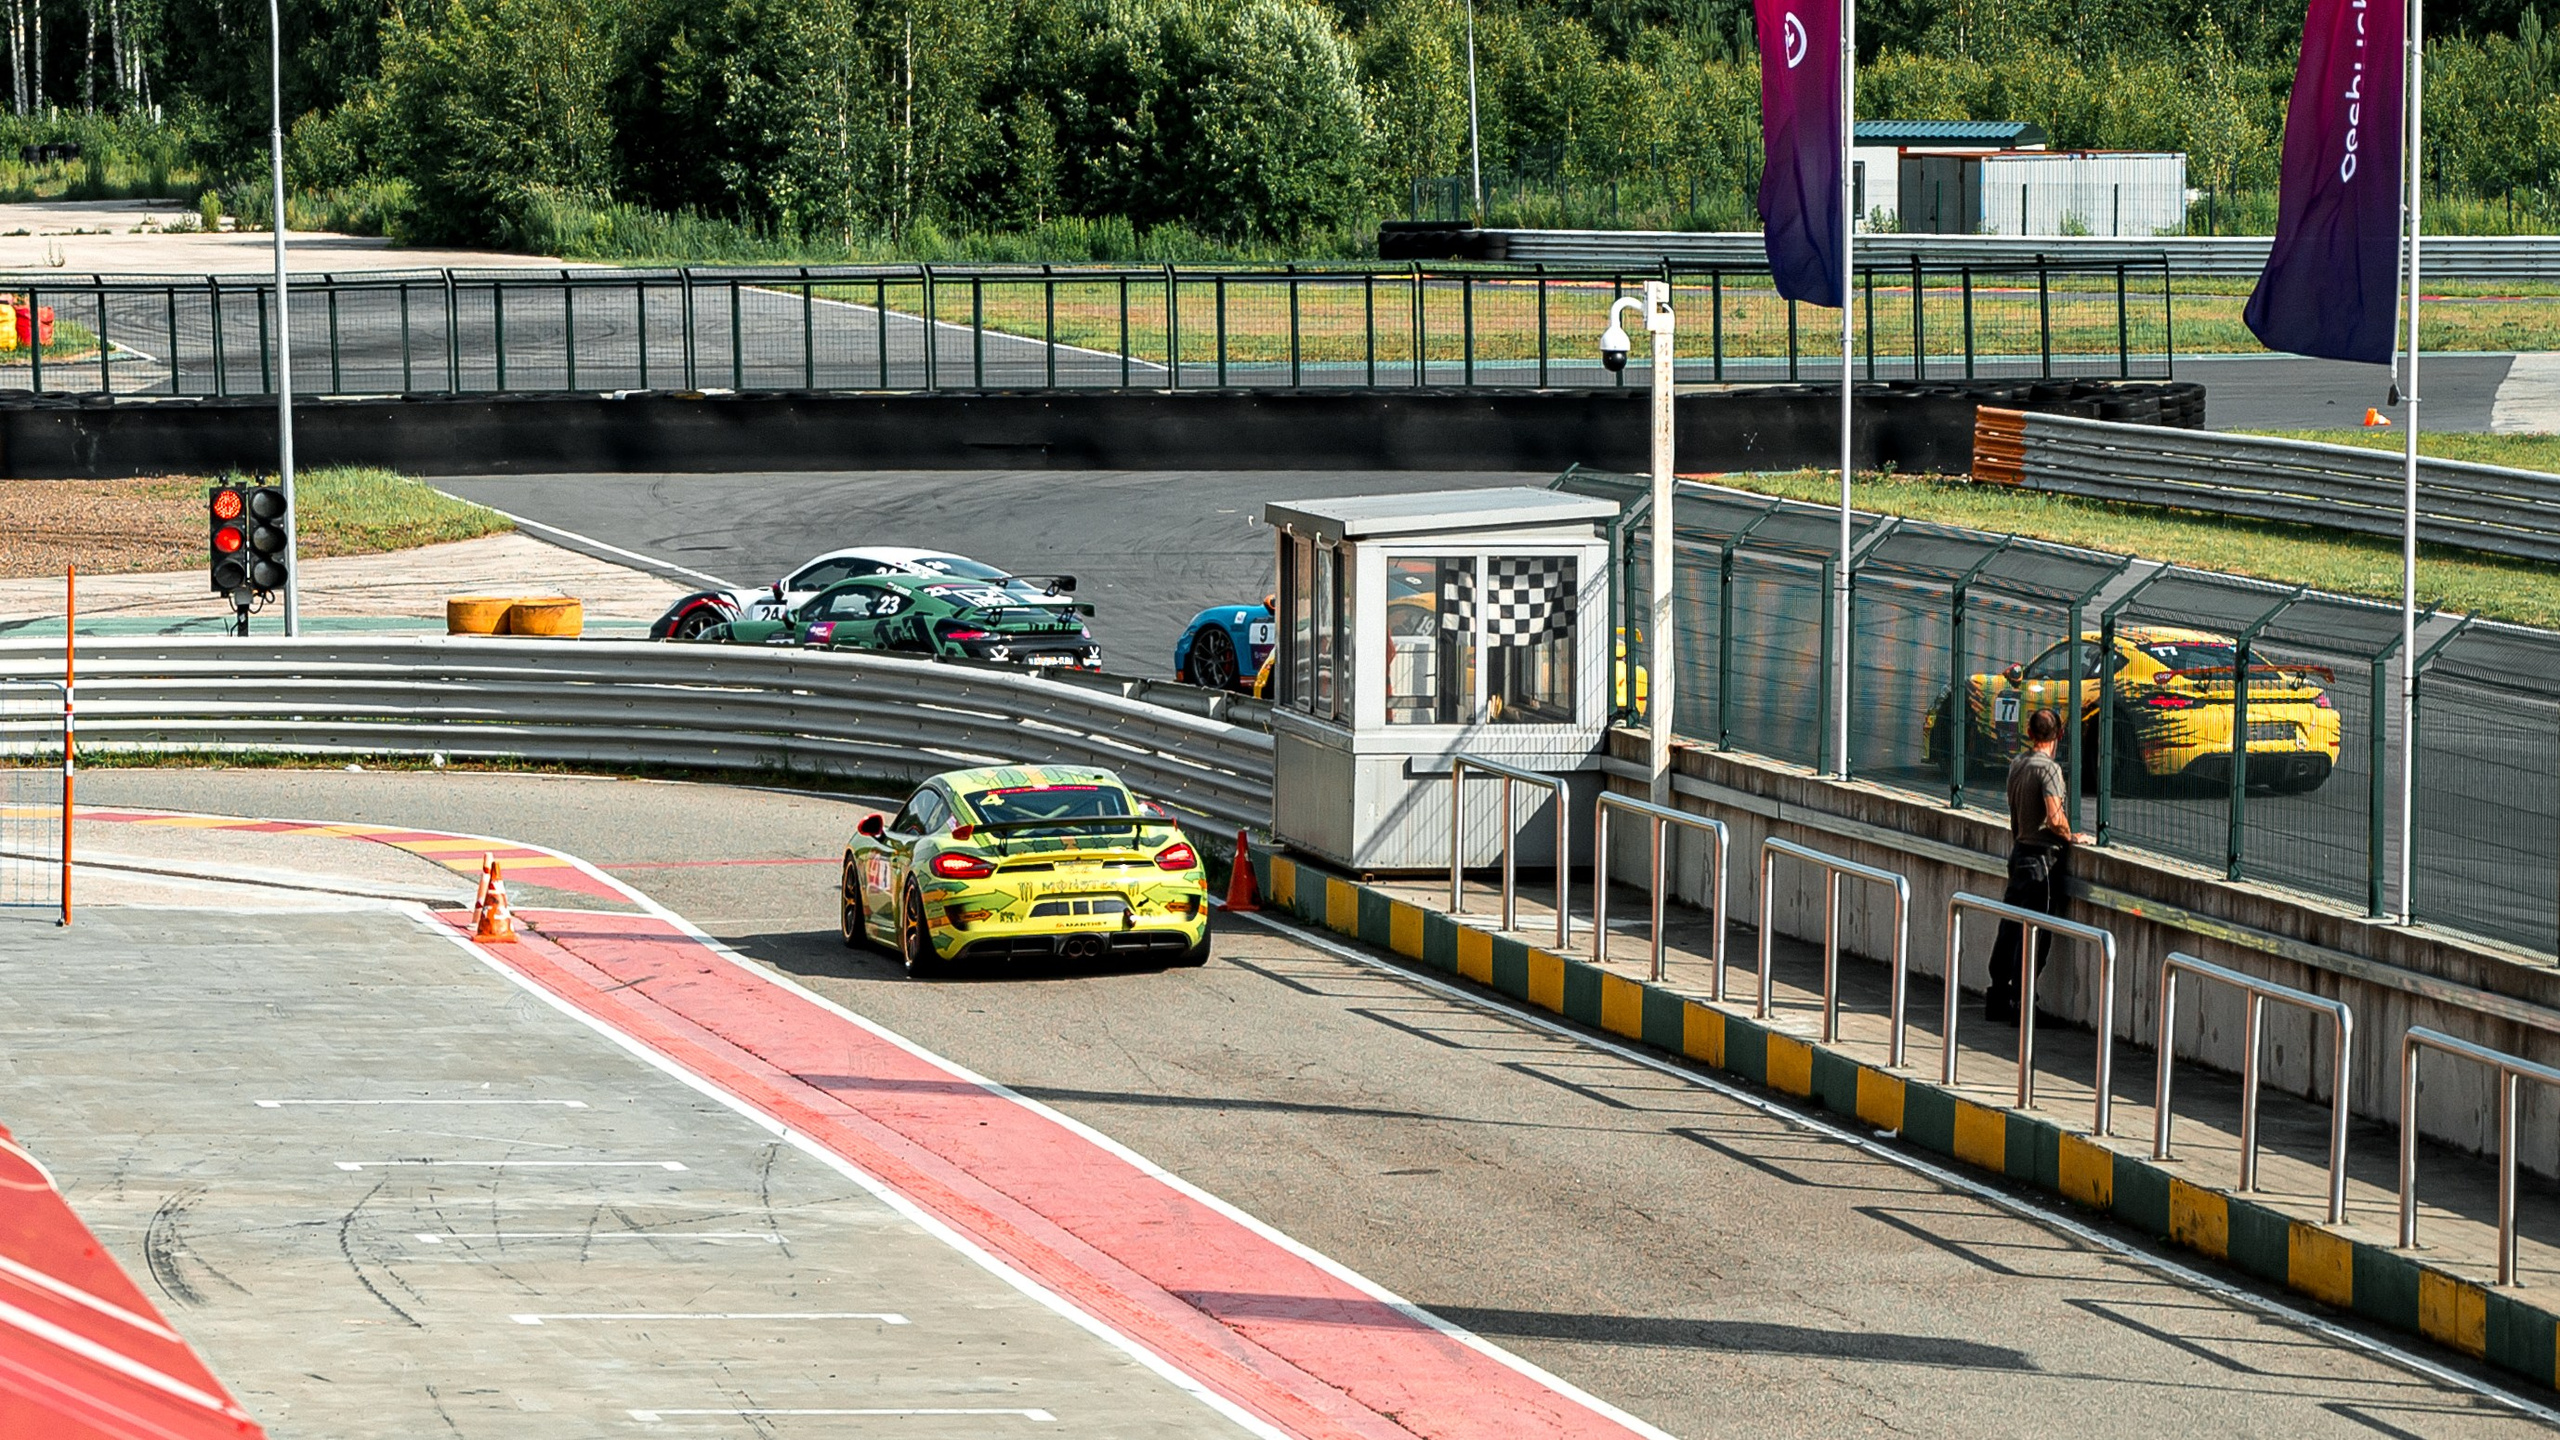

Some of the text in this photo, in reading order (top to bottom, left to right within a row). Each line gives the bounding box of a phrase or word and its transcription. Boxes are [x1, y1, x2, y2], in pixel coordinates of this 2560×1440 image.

[761, 606, 780, 621] 24
[876, 595, 900, 614] 23
[1259, 625, 1268, 643] 9
[1416, 616, 1435, 636] 19
[2002, 700, 2016, 720] 77
[980, 793, 1005, 805] 4
[1042, 879, 1120, 894] MONSTER
